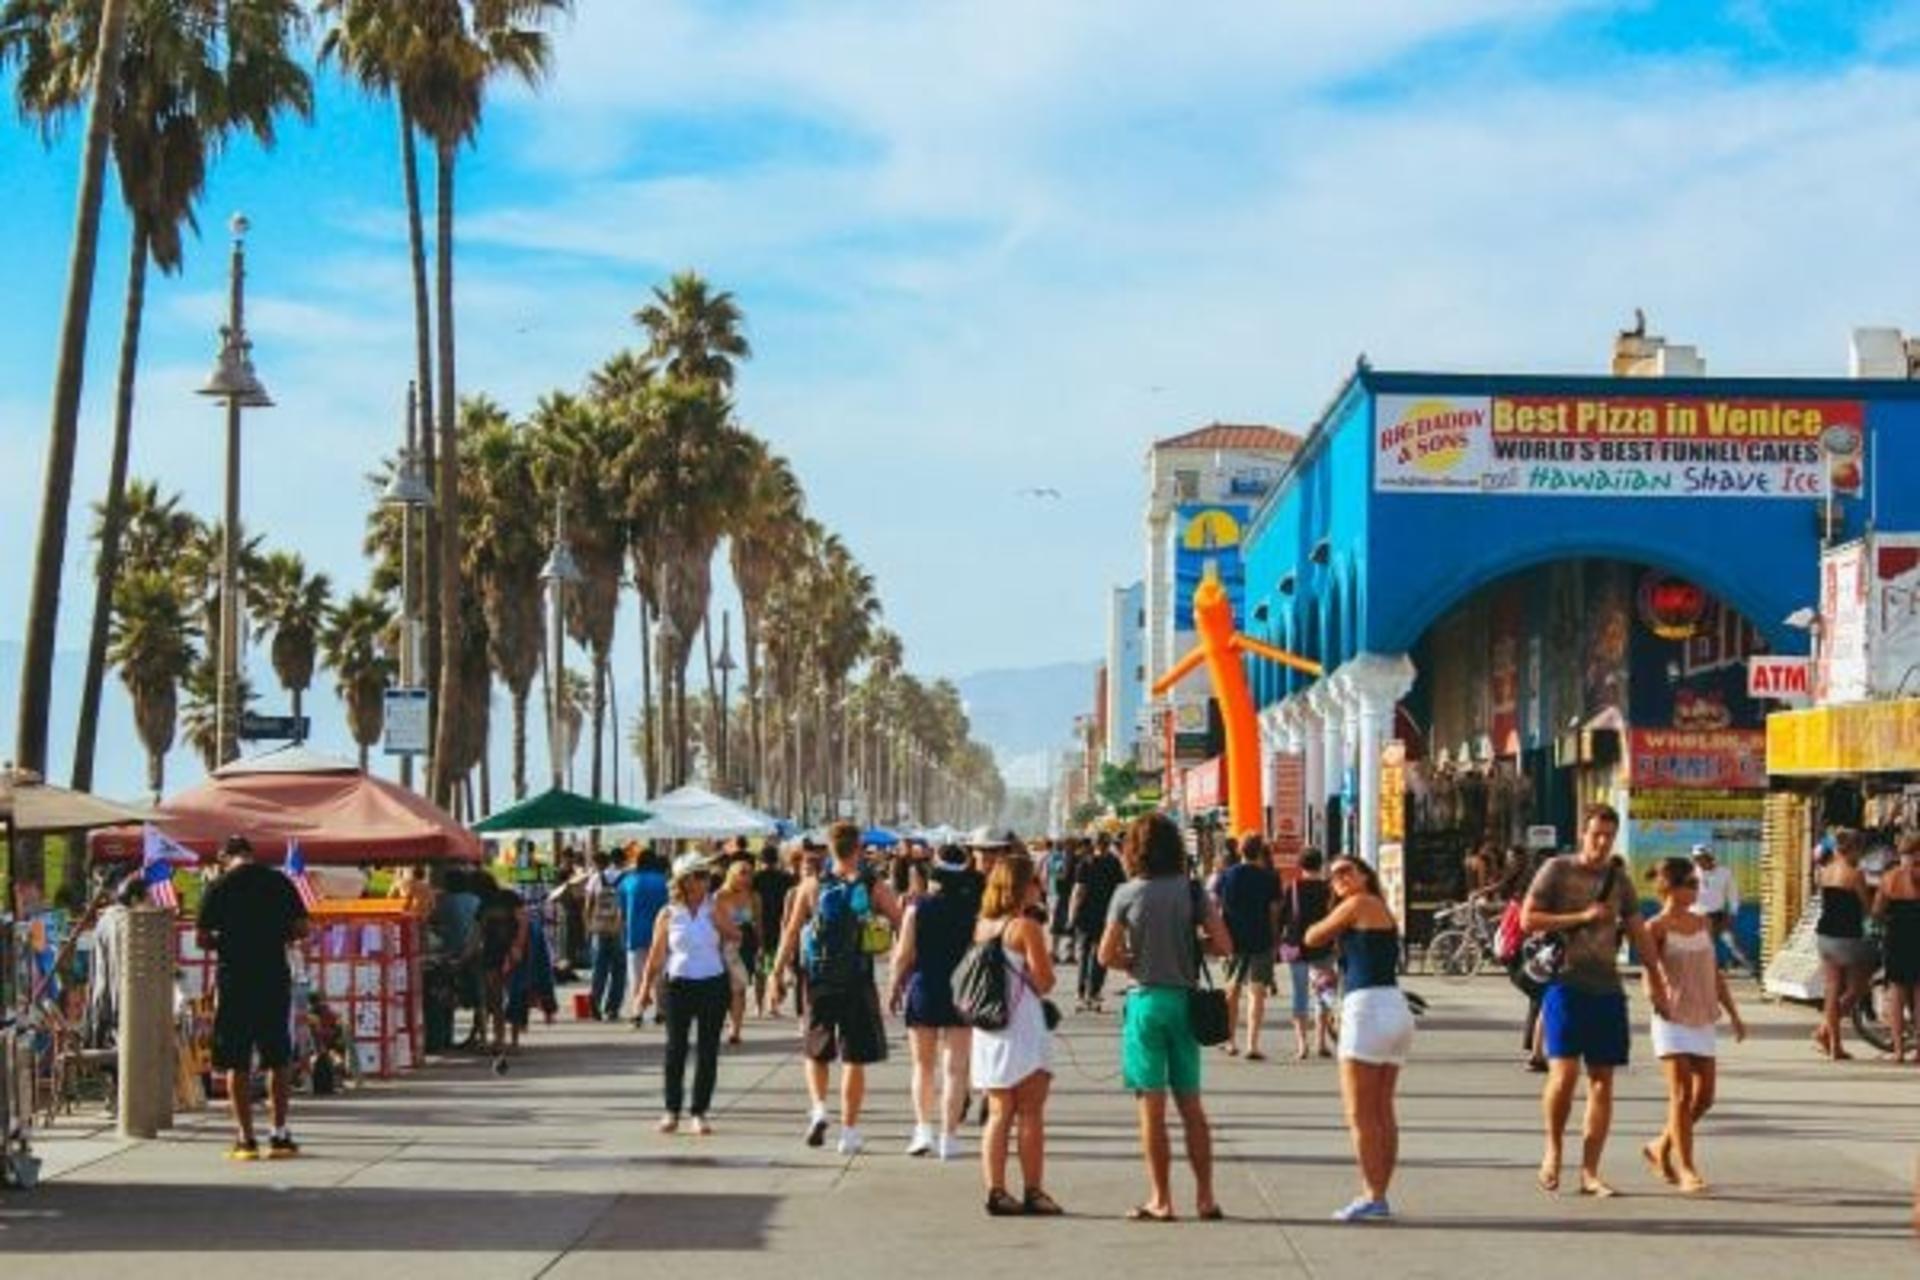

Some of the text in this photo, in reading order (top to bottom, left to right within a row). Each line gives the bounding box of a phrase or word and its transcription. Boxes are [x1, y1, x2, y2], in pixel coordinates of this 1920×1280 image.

[1417, 409, 1485, 436] DADDY
[1493, 401, 1822, 436] Best Pizza in Venice
[1417, 433, 1469, 459] SONS
[1600, 441, 1654, 462] BEST
[1661, 441, 1742, 462] FUNNEL
[1746, 441, 1819, 463] CAKES
[1752, 664, 1806, 692] ATM
